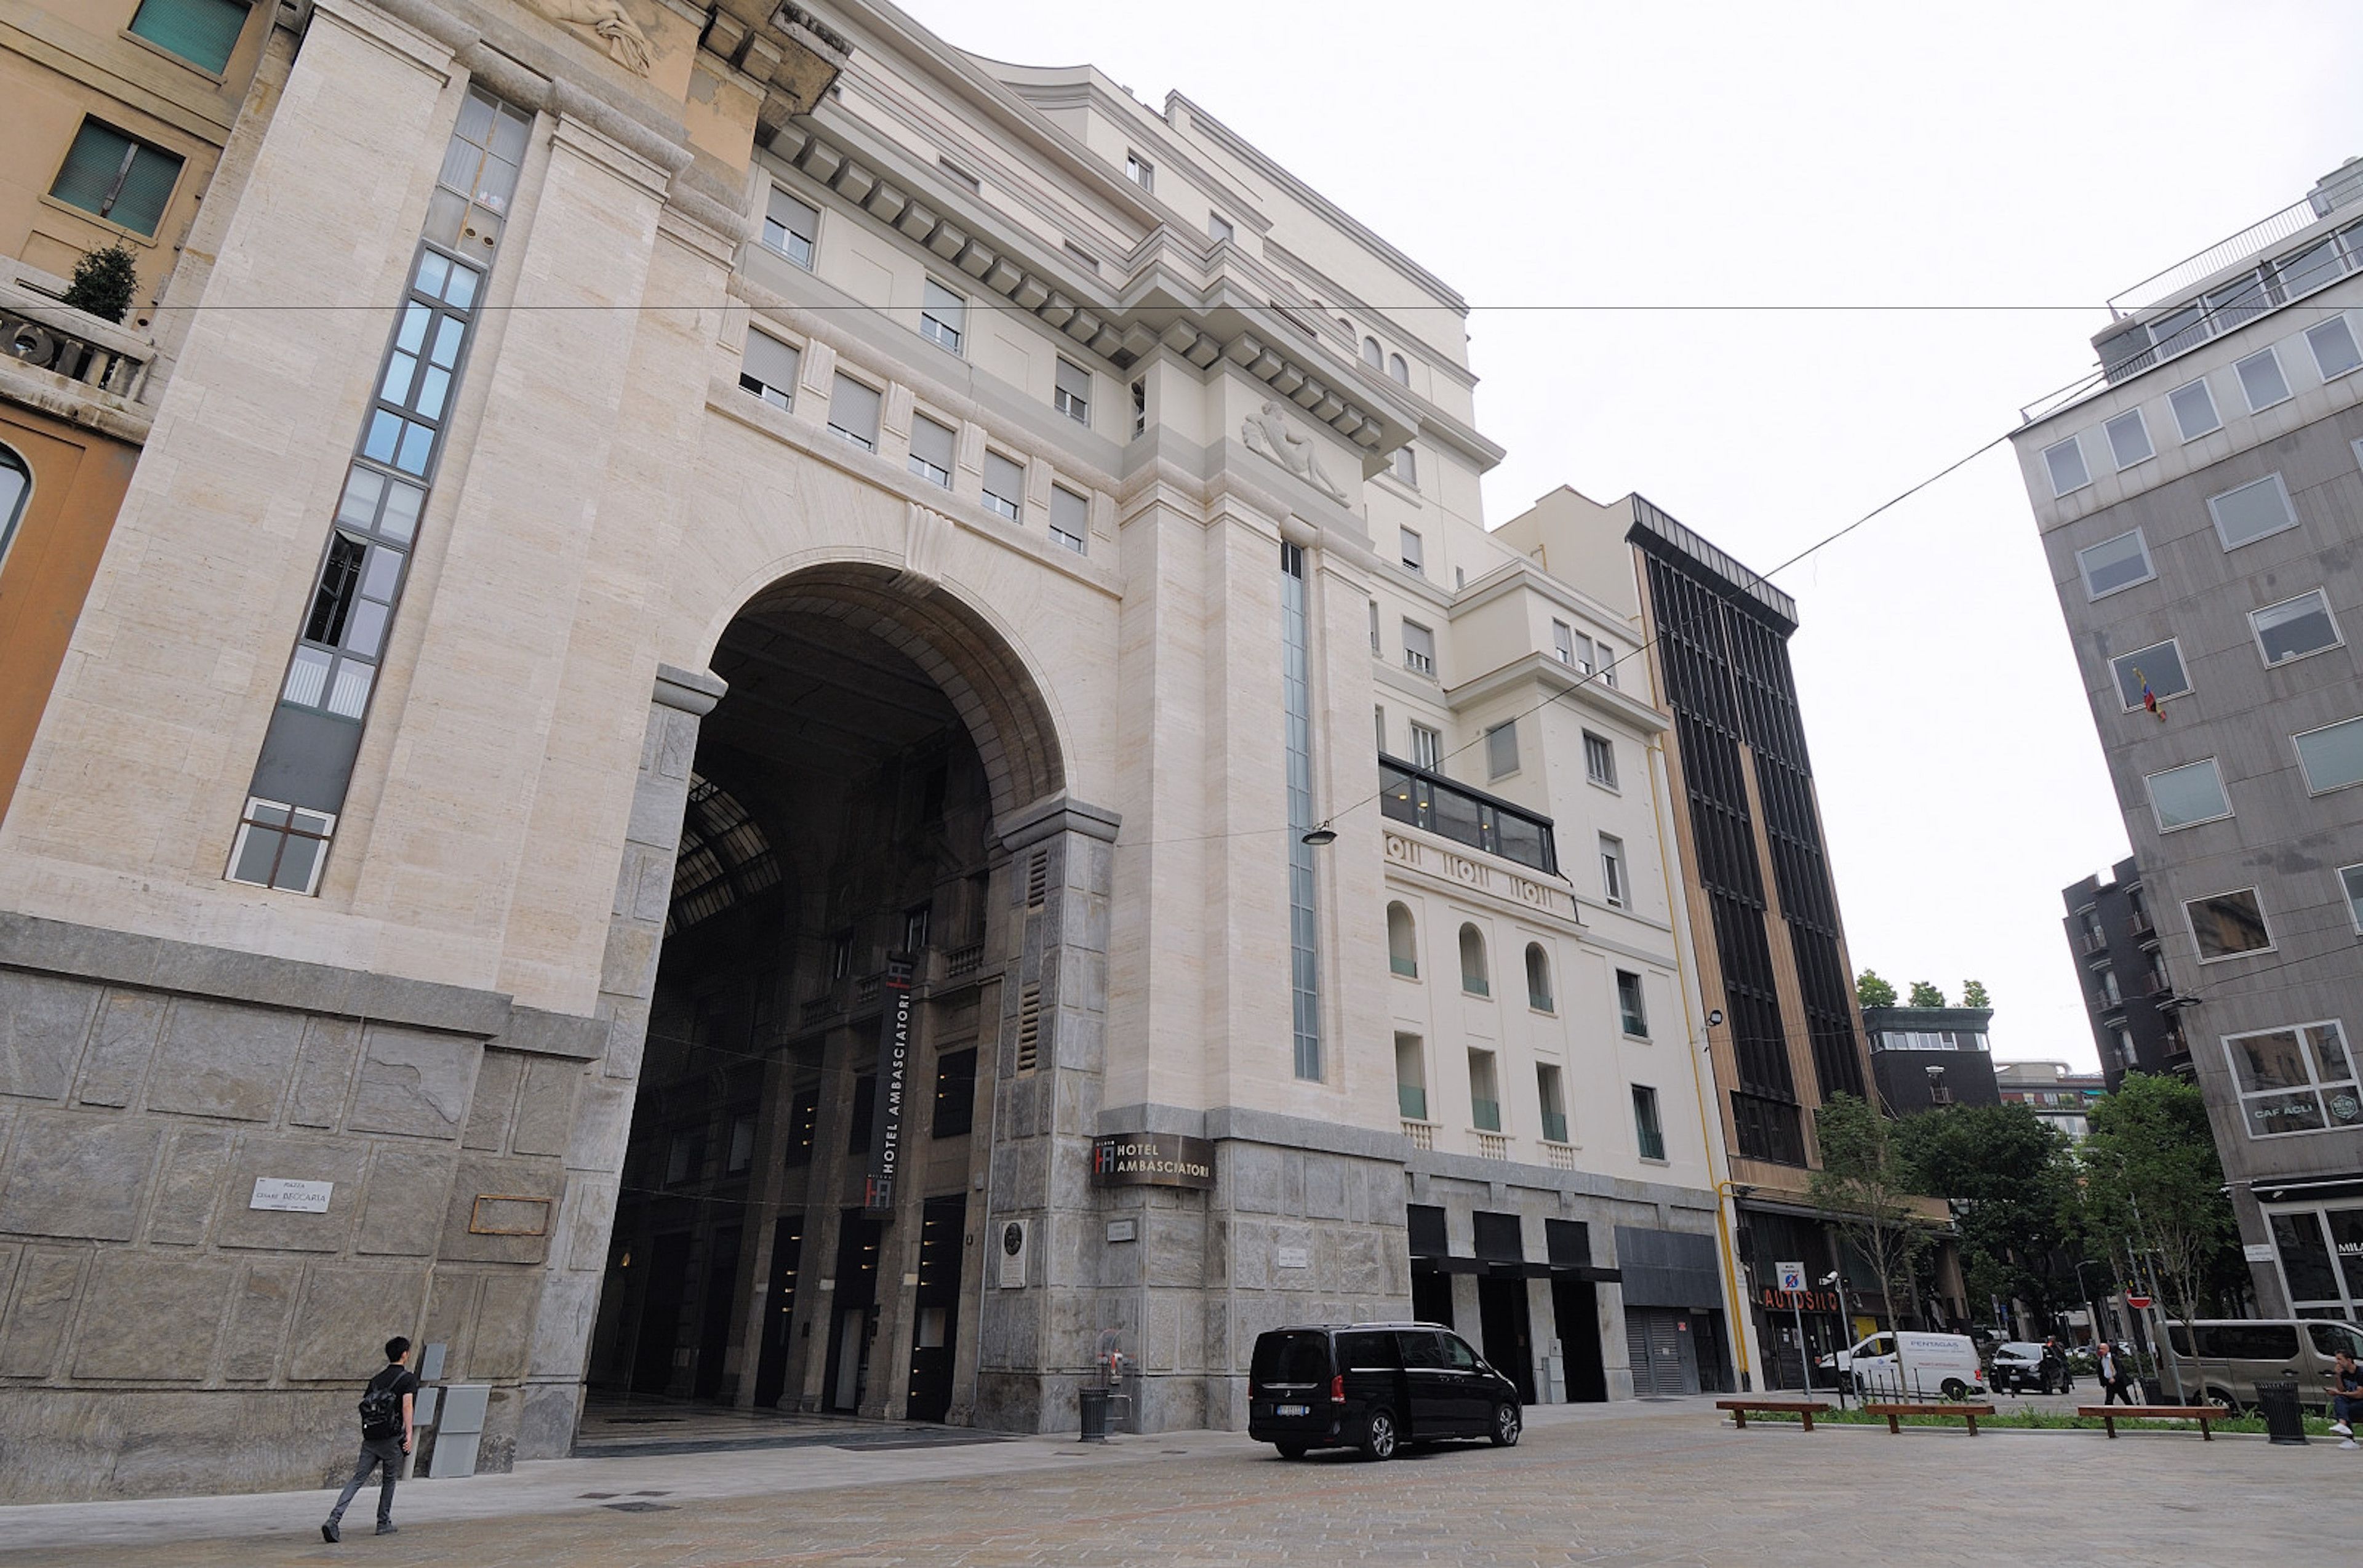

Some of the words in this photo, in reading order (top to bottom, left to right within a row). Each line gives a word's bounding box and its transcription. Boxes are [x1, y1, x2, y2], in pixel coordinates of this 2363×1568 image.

[889, 994, 910, 1116] AMBASCIATORI
[2255, 1108, 2279, 1119] CAF
[2284, 1105, 2313, 1114] ACLI
[882, 1124, 898, 1174] HOTEL
[1117, 1144, 1159, 1156] HOTEL
[1117, 1160, 1209, 1178] AMBASCIATORI
[1765, 1289, 1838, 1311] AUTOSILO
